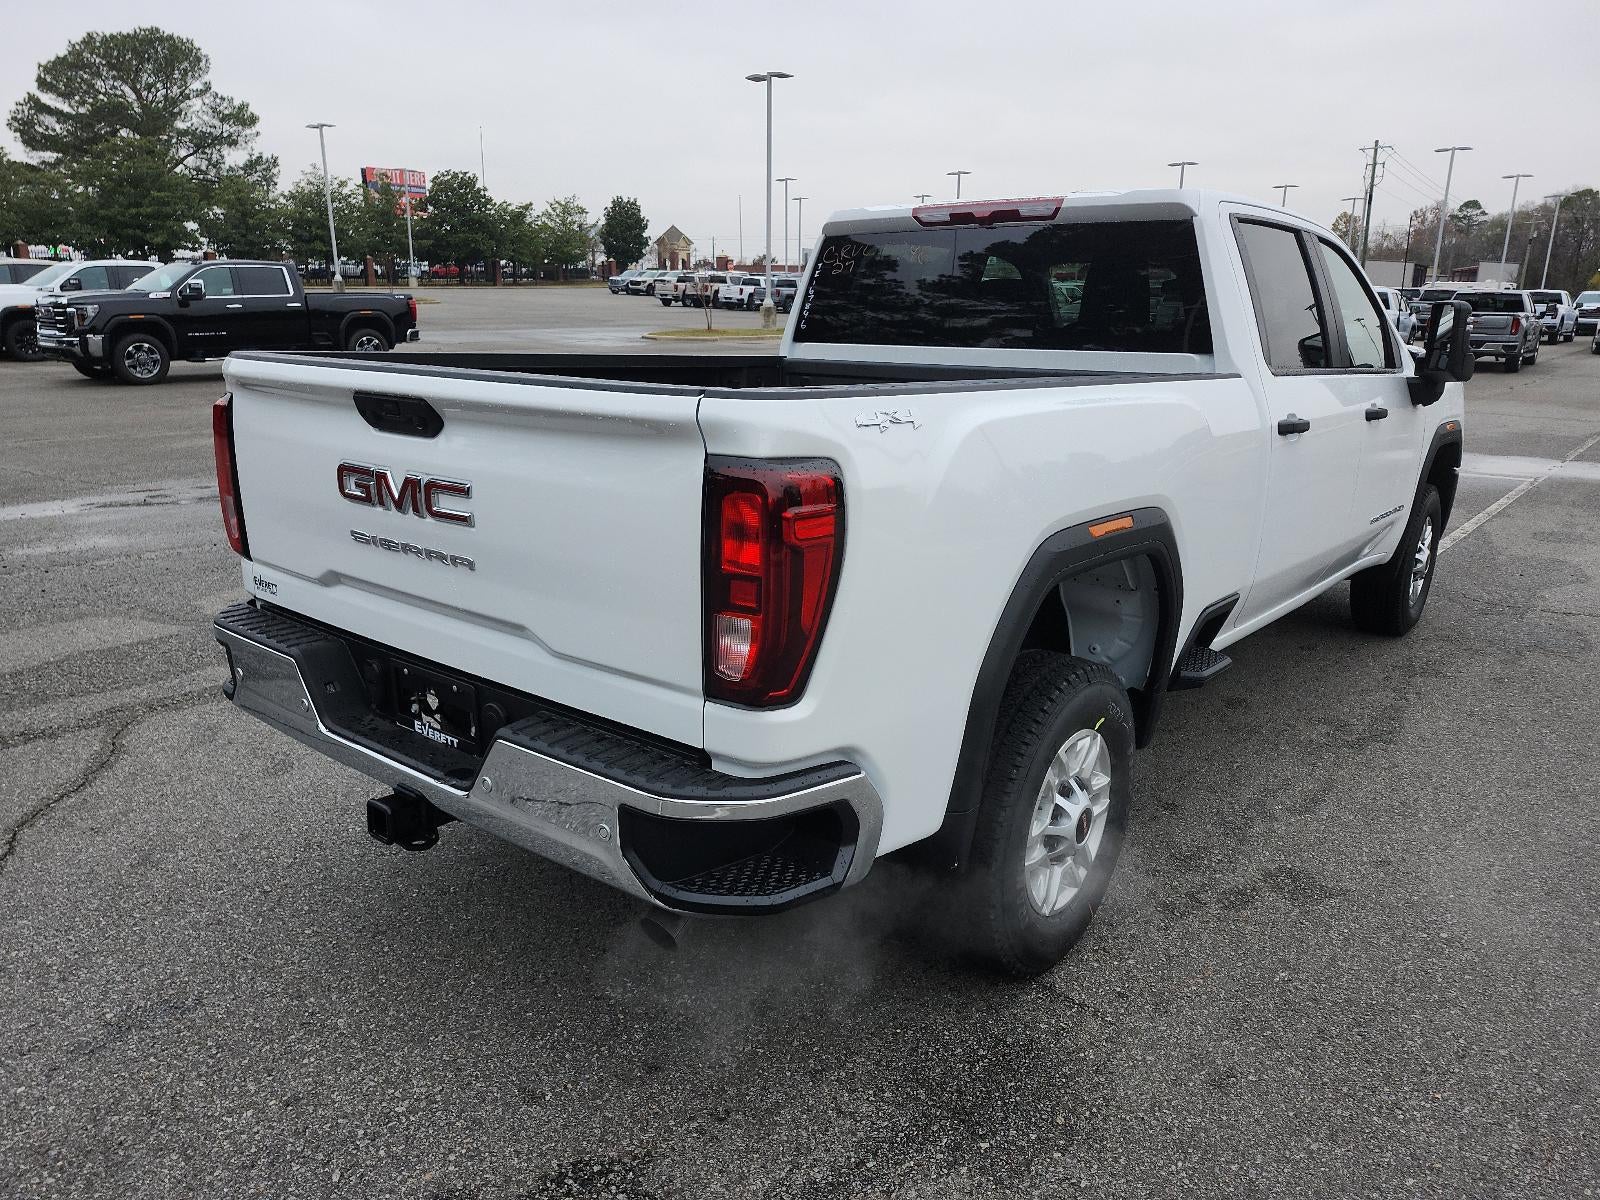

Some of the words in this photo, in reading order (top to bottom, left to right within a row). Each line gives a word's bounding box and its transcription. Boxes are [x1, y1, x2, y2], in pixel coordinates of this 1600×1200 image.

[831, 259, 855, 275] 27
[336, 459, 476, 529] GMC
[350, 529, 476, 572] SIERRA
[414, 719, 459, 748] EVERETT
